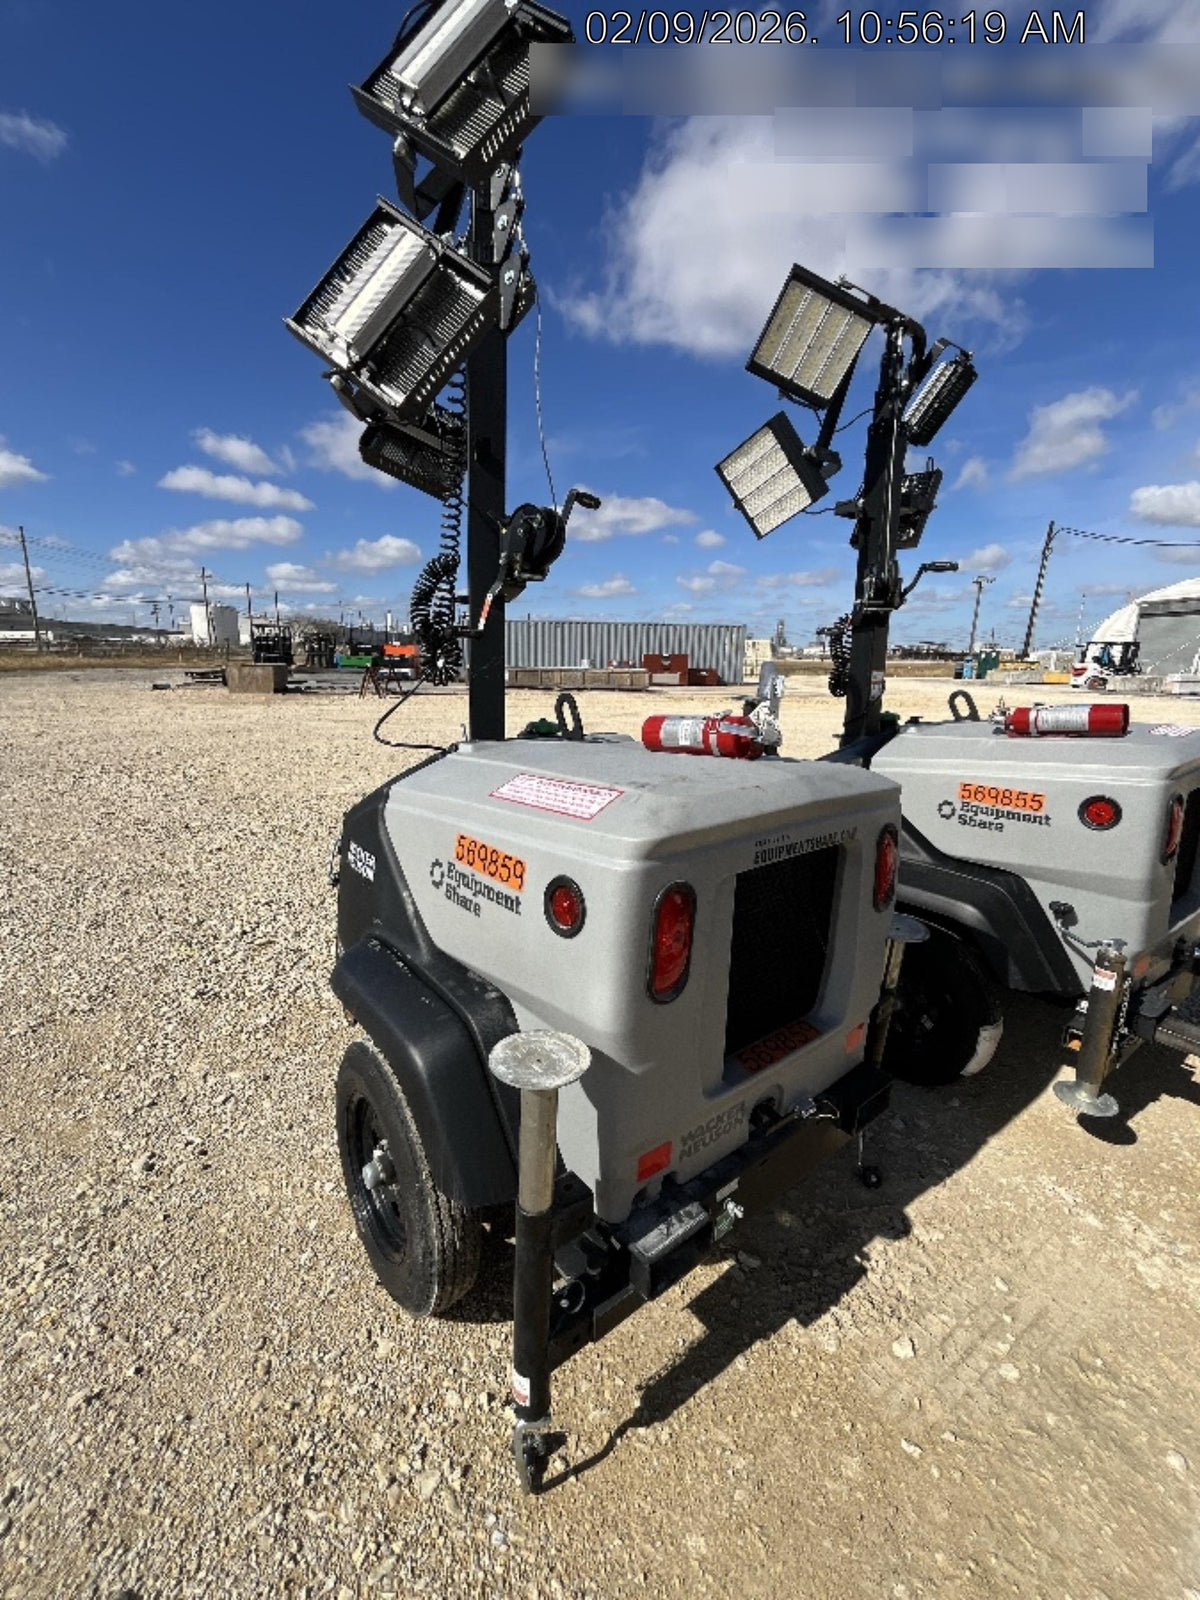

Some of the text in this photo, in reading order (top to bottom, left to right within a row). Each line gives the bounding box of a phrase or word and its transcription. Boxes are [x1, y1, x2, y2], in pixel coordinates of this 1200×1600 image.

[960, 783, 1044, 812] 569855
[958, 814, 1004, 833] Share
[960, 801, 1052, 827] Equipment
[455, 834, 526, 890] 569859
[445, 883, 481, 918] Share
[446, 861, 522, 916] Equipment
